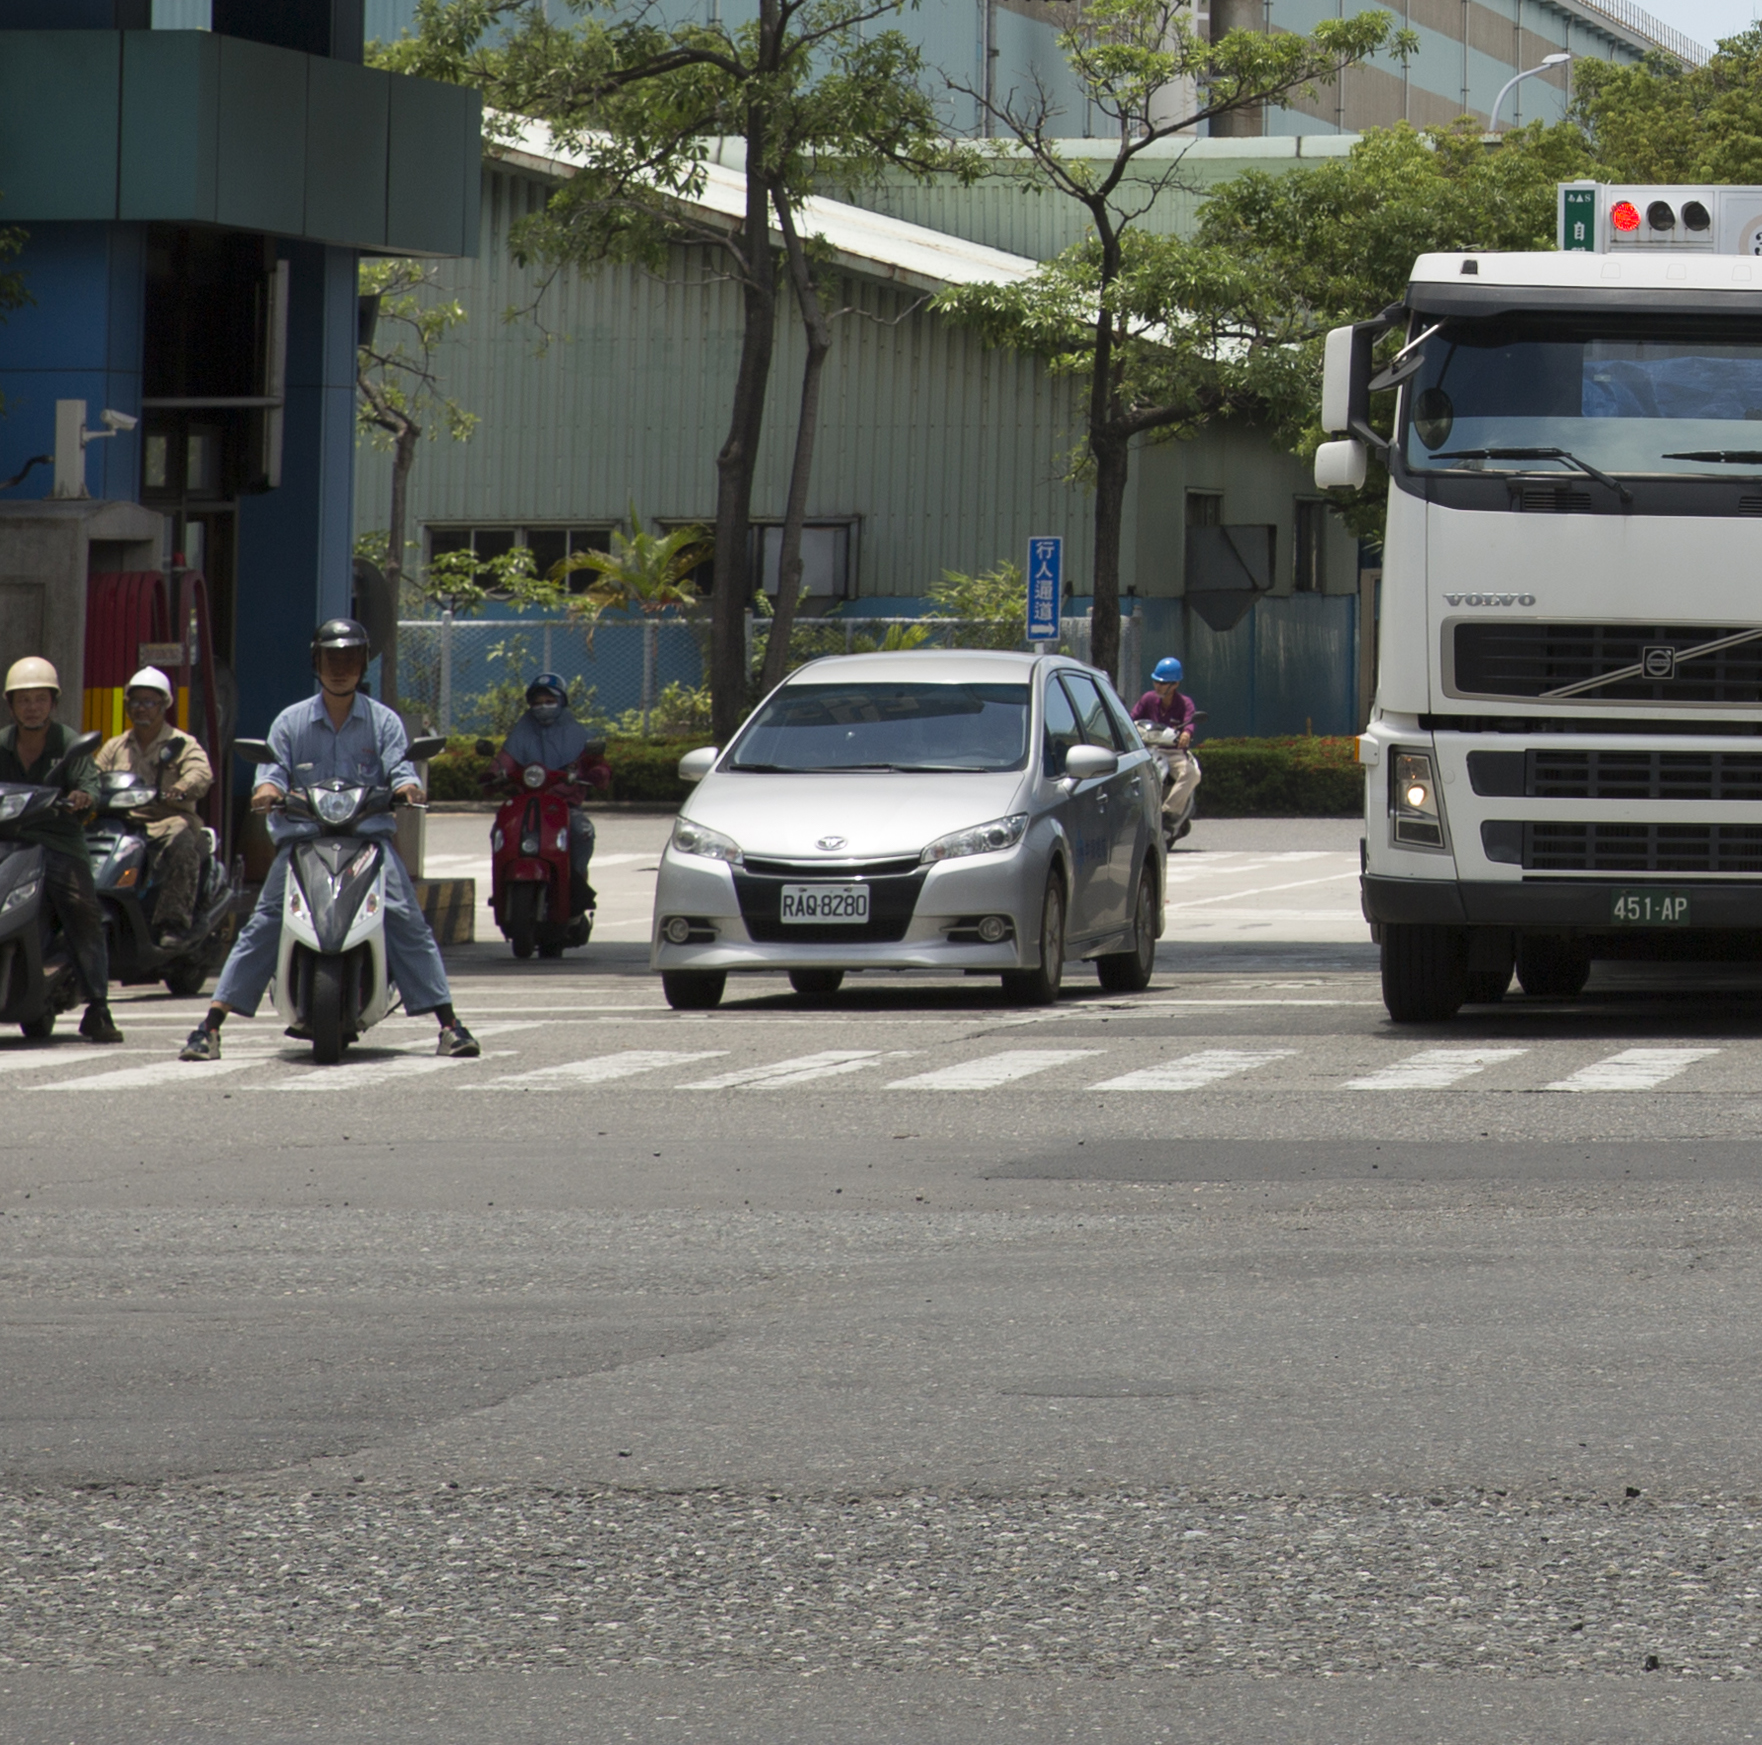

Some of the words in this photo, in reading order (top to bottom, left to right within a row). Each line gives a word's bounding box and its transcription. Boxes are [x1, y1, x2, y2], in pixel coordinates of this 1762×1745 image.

[1034, 541, 1055, 621] 行人通道
[1442, 592, 1537, 607] VOLVO
[782, 894, 867, 917] RAQ-8280
[1613, 896, 1688, 921] 451-AP
